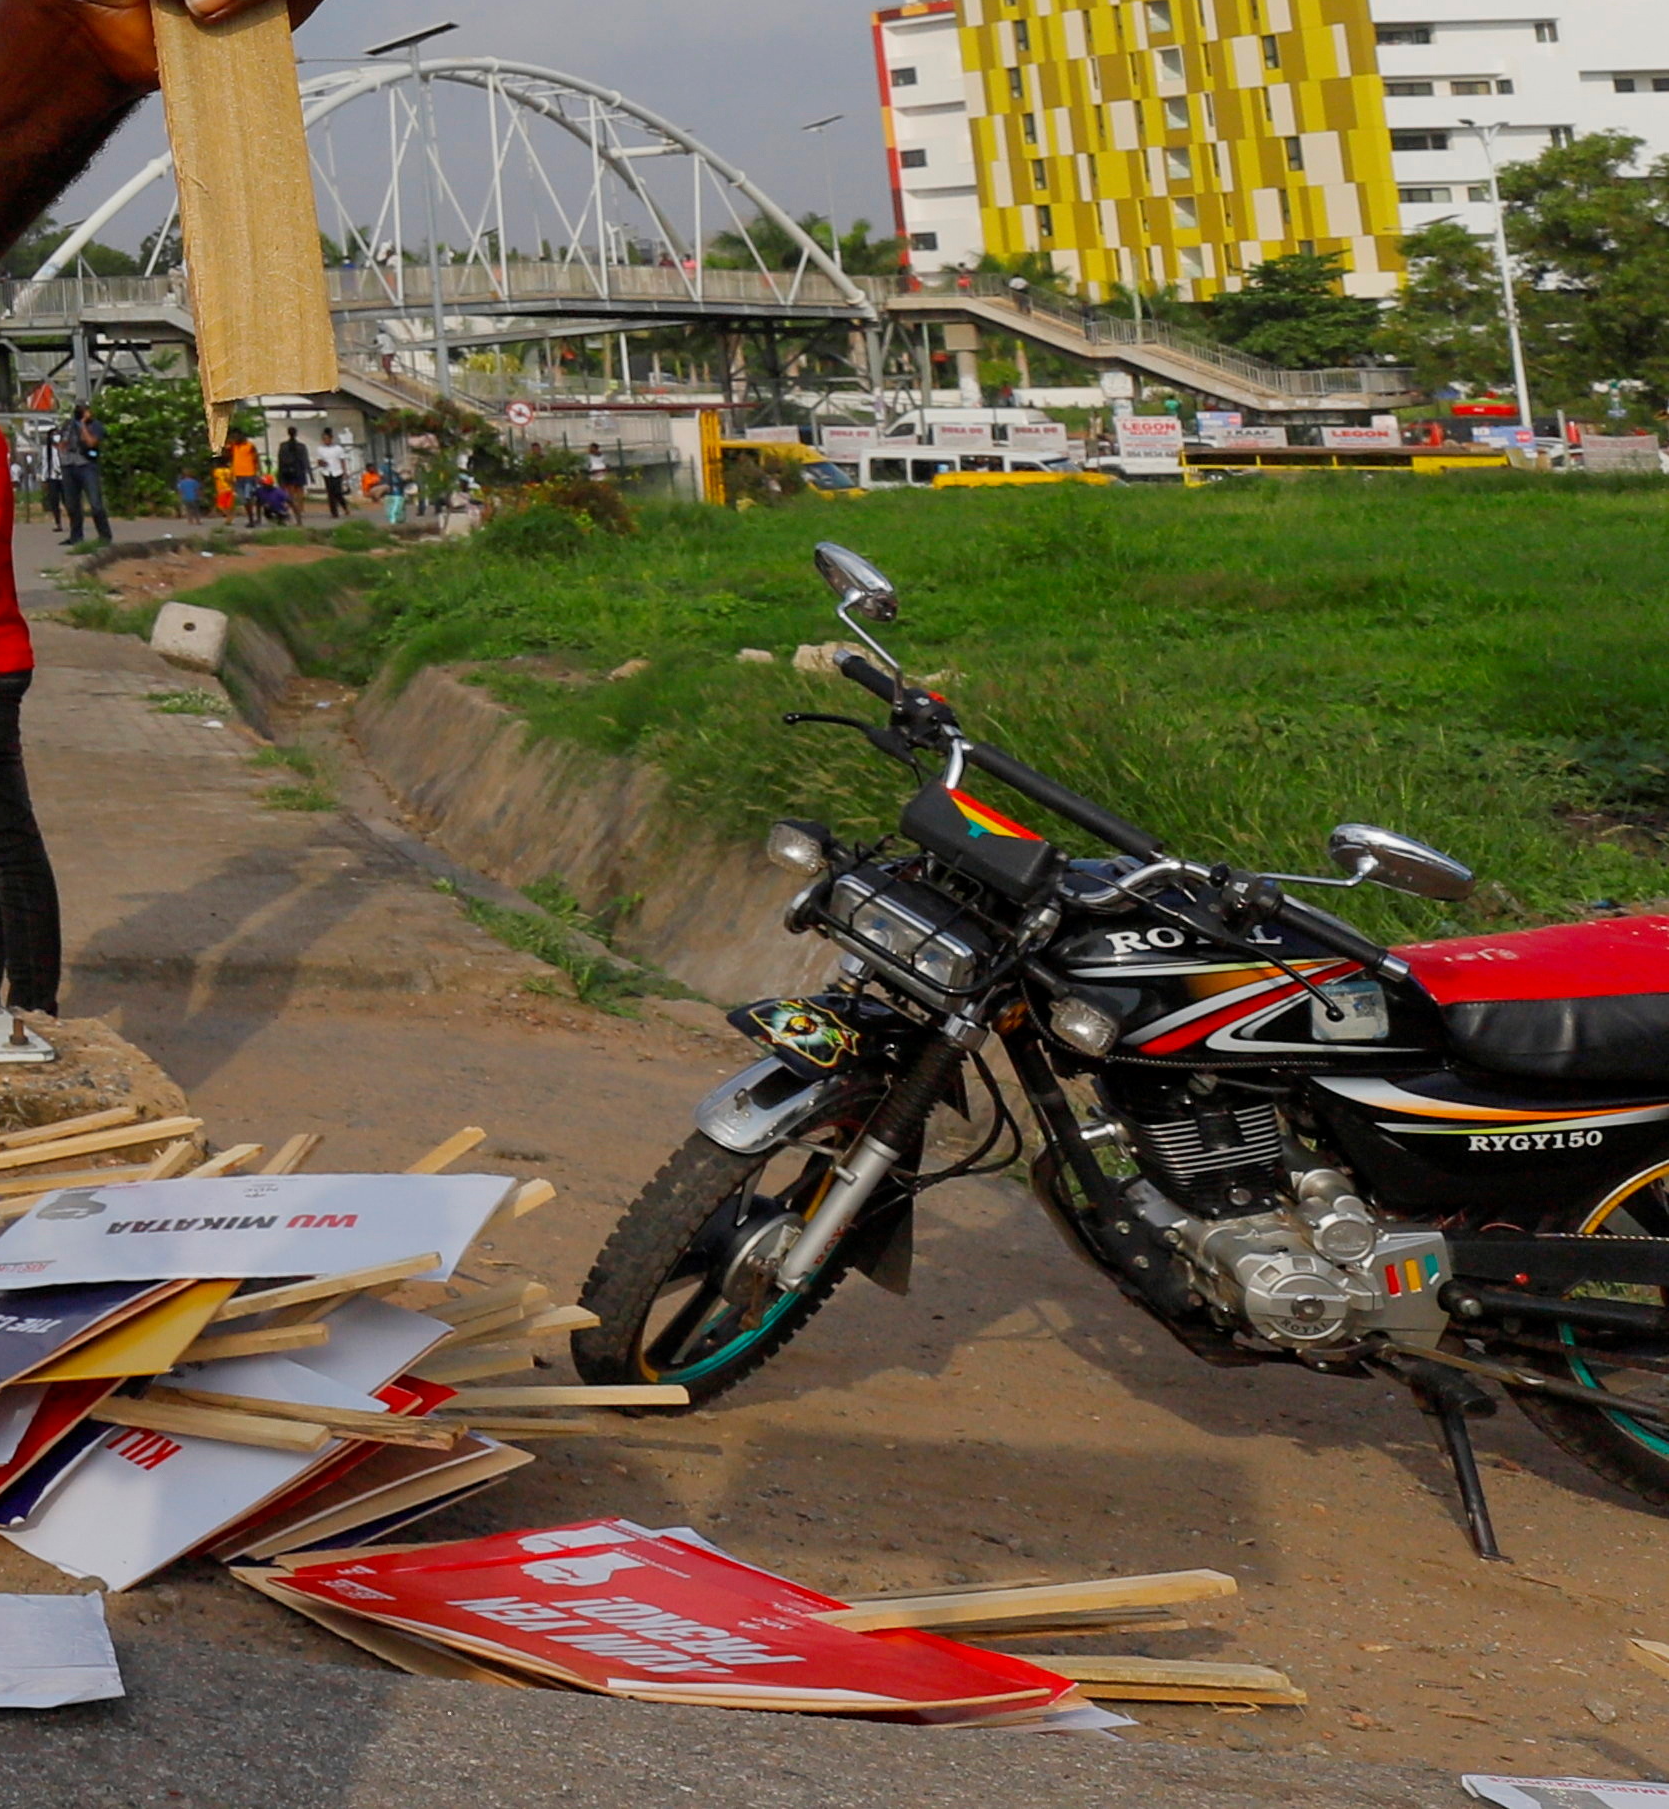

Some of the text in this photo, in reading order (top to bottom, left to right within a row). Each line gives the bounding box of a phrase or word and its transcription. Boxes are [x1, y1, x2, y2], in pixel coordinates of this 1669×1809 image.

[1104, 923, 1282, 953] ROL
[1468, 1130, 1602, 1150] RYGY150
[103, 1212, 358, 1234] WU MIKATAA
[5, 1315, 60, 1334] THE
[451, 1595, 590, 1631] YEN
